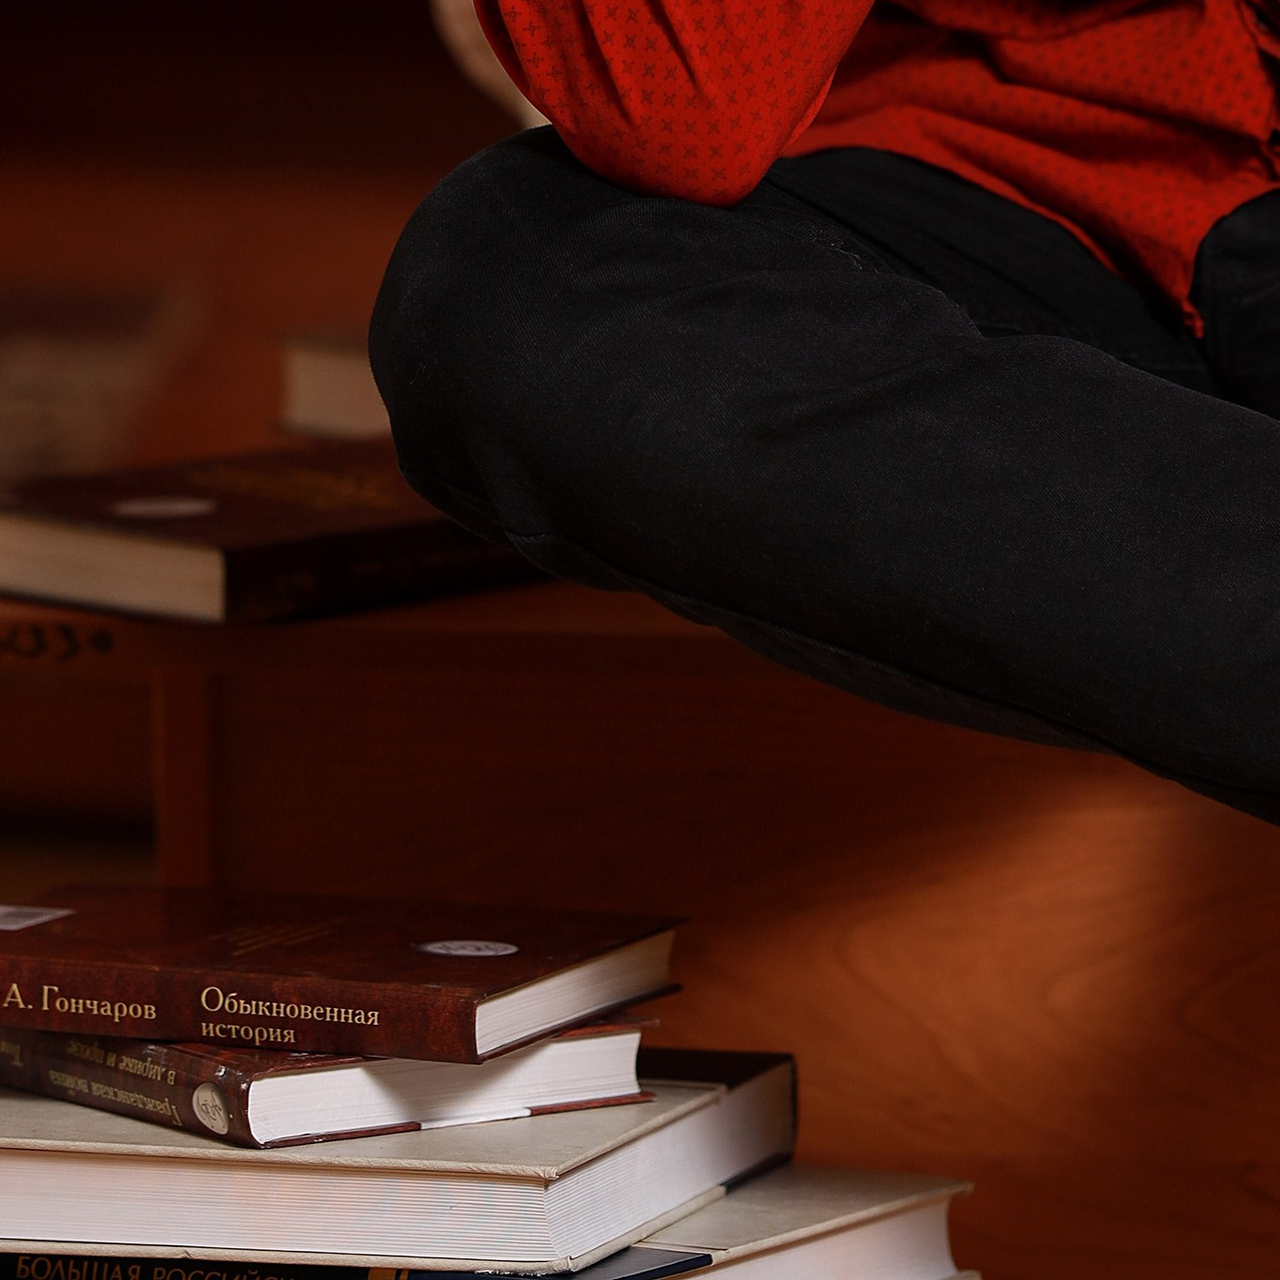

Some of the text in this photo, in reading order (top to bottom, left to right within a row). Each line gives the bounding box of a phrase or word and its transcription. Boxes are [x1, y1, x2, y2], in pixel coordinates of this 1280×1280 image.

[3, 982, 157, 1022] А. Гончаров
[200, 985, 380, 1027] Обыкновенная
[200, 1020, 296, 1045] история
[118, 1055, 166, 1082] лирике
[91, 1080, 183, 1126] Гражданская
